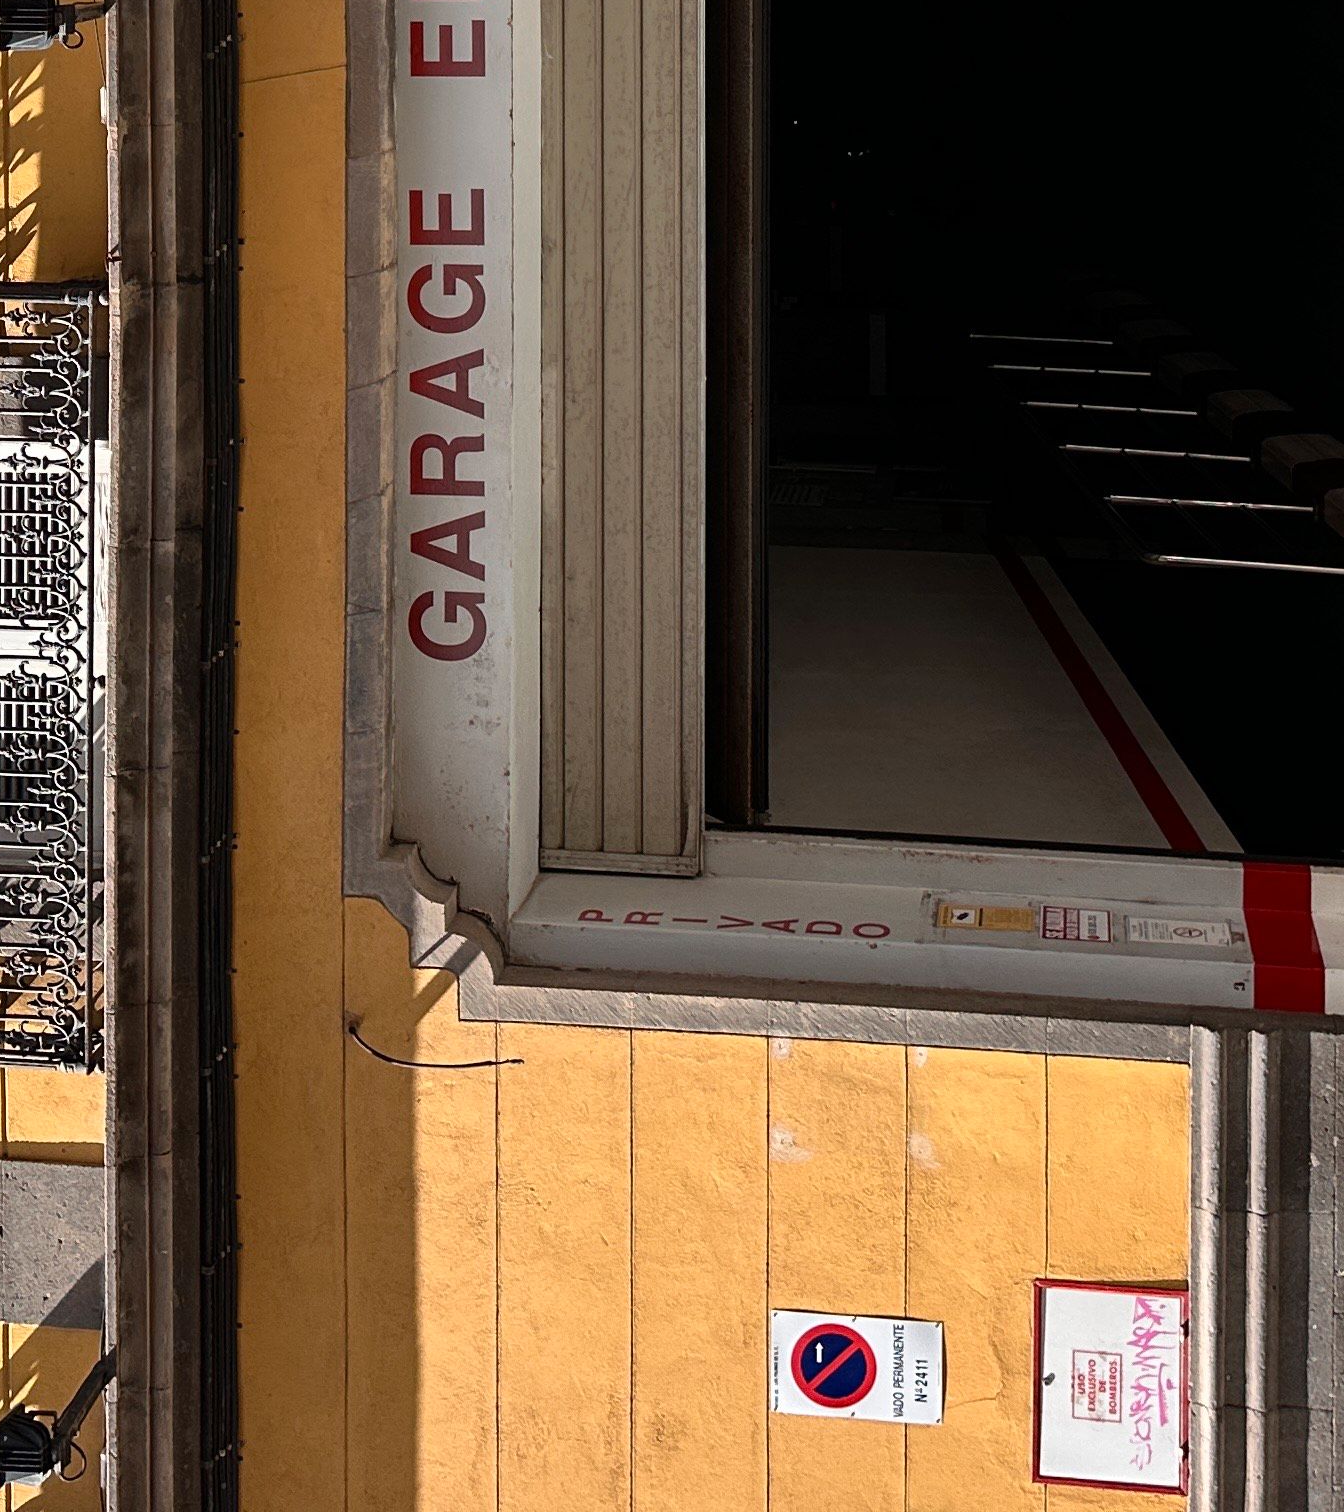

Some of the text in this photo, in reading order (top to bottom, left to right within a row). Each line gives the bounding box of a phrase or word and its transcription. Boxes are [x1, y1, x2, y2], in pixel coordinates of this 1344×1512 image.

[406, 188, 486, 661] GARAGE
[577, 909, 891, 939] PRIVADO
[892, 1323, 905, 1417] VADO PERMANENTE
[1077, 1374, 1086, 1395] USO
[1087, 1359, 1096, 1412] EXCLUSIVO
[1098, 1380, 1107, 1393] DE
[1108, 1361, 1118, 1415] BOMBEROS
